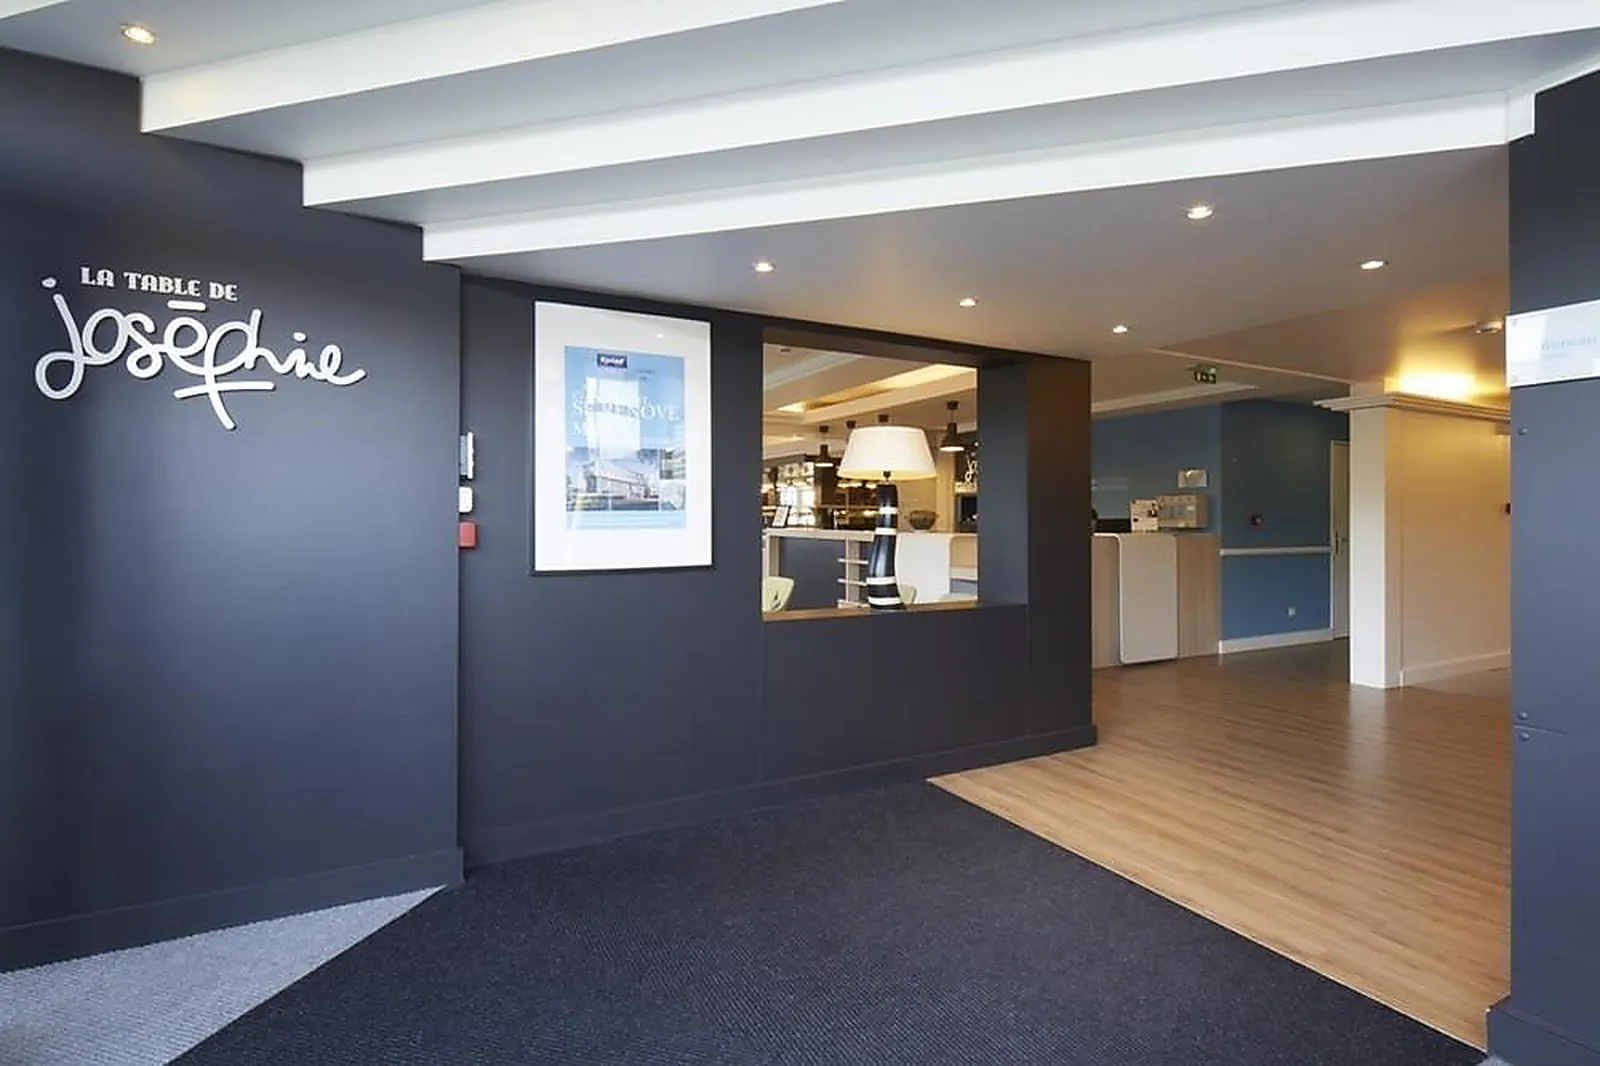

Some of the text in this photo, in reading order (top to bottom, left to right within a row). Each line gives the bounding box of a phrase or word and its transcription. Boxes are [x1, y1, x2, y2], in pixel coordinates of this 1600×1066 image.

[80, 266, 239, 301] LA TABLE DE
